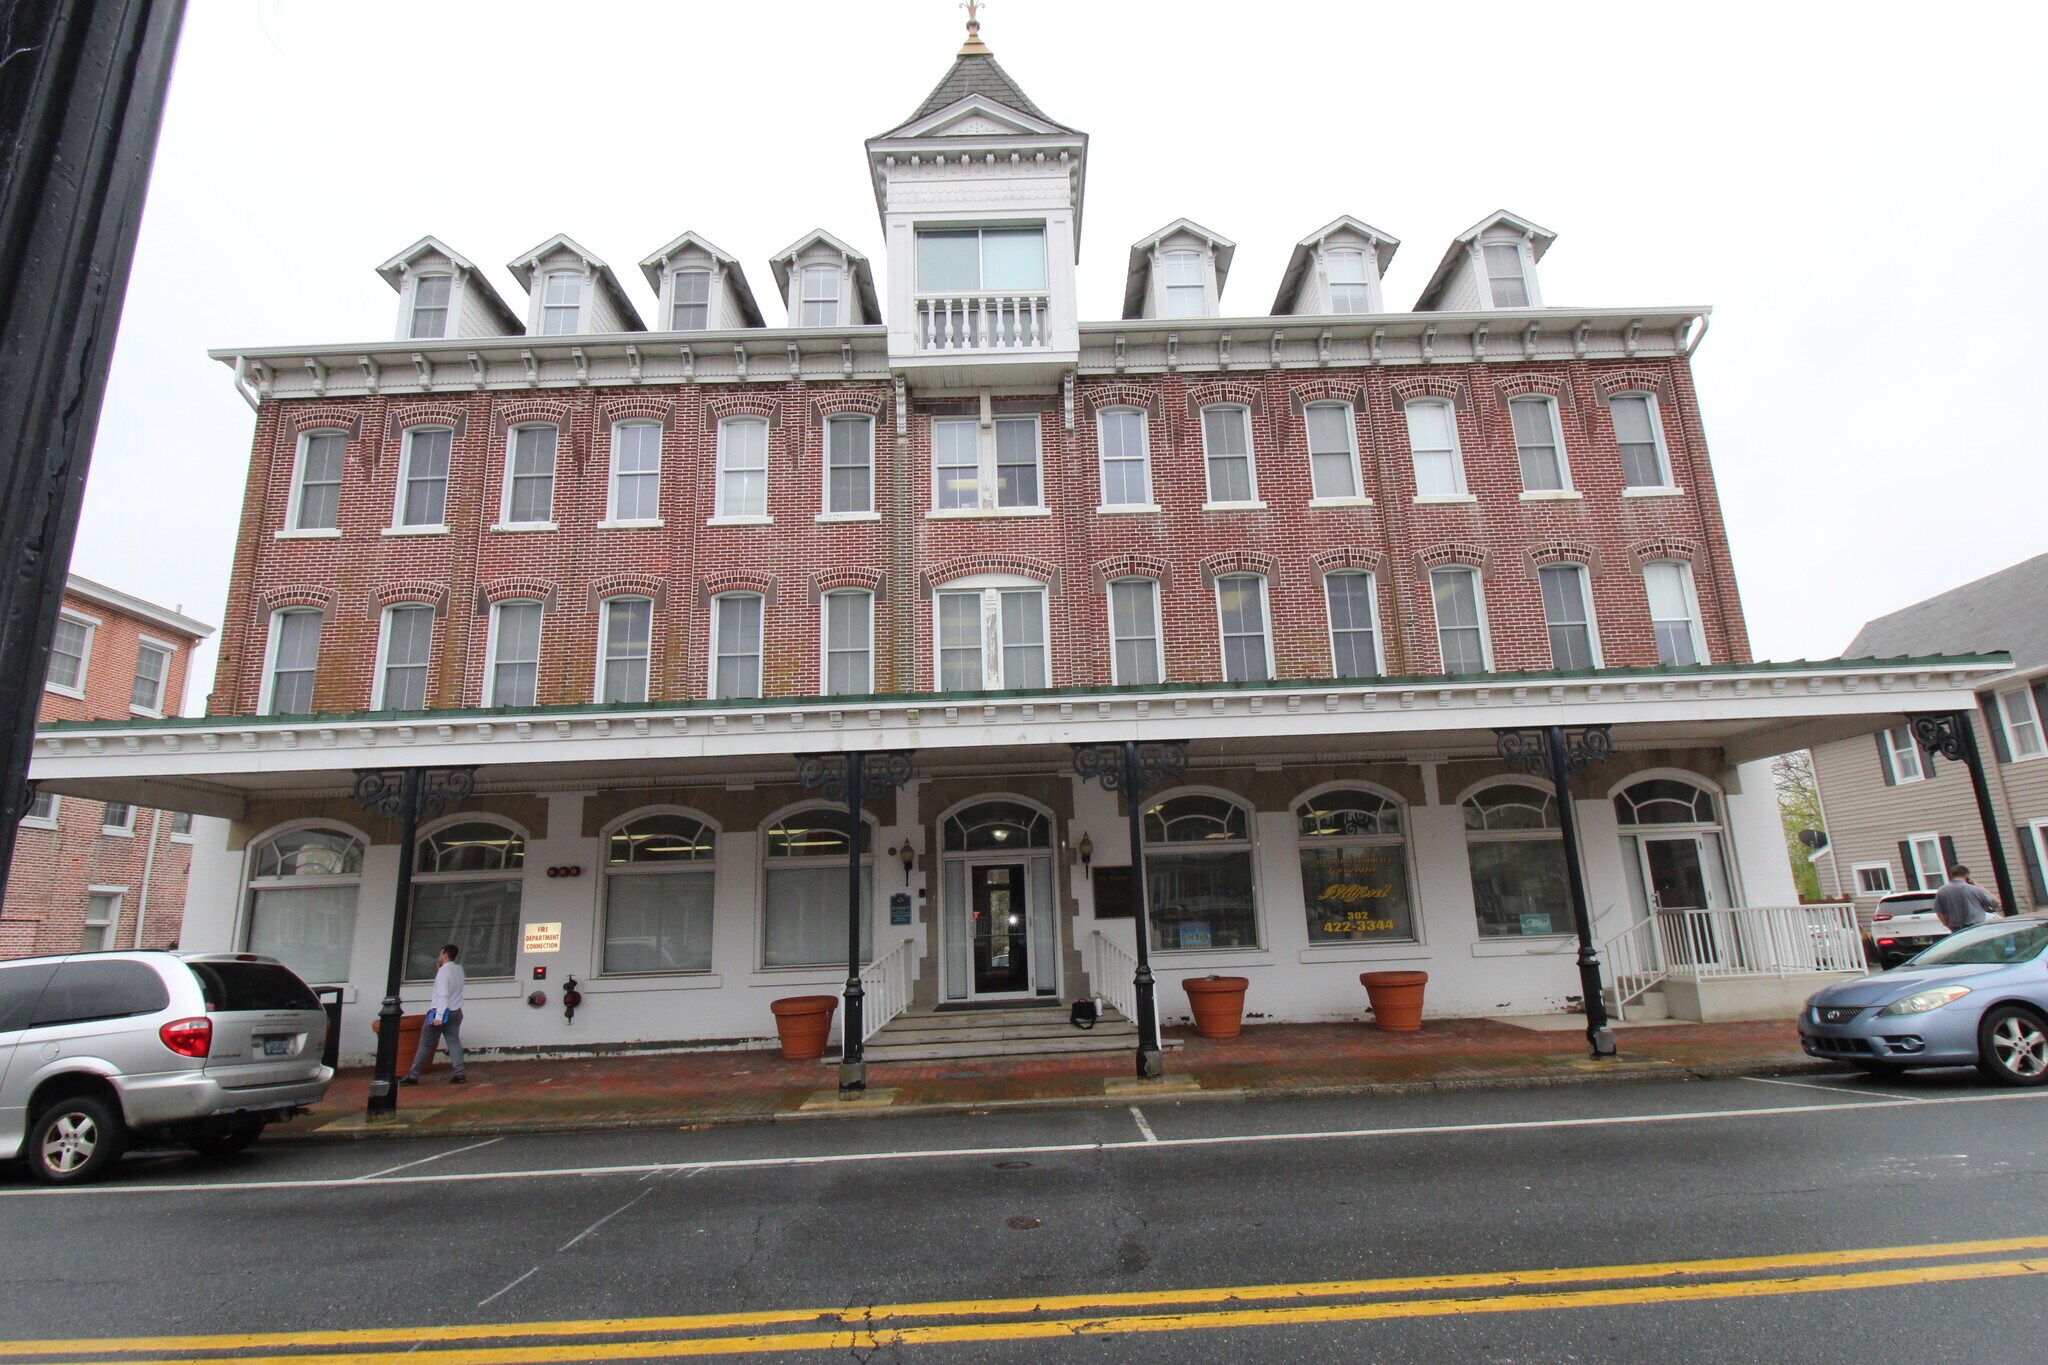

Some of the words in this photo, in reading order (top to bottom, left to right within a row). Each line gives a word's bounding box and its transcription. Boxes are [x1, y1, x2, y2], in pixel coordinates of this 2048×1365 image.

[1316, 883, 1392, 902] Milford
[1347, 911, 1368, 919] 302
[1324, 919, 1394, 932] 422-3344
